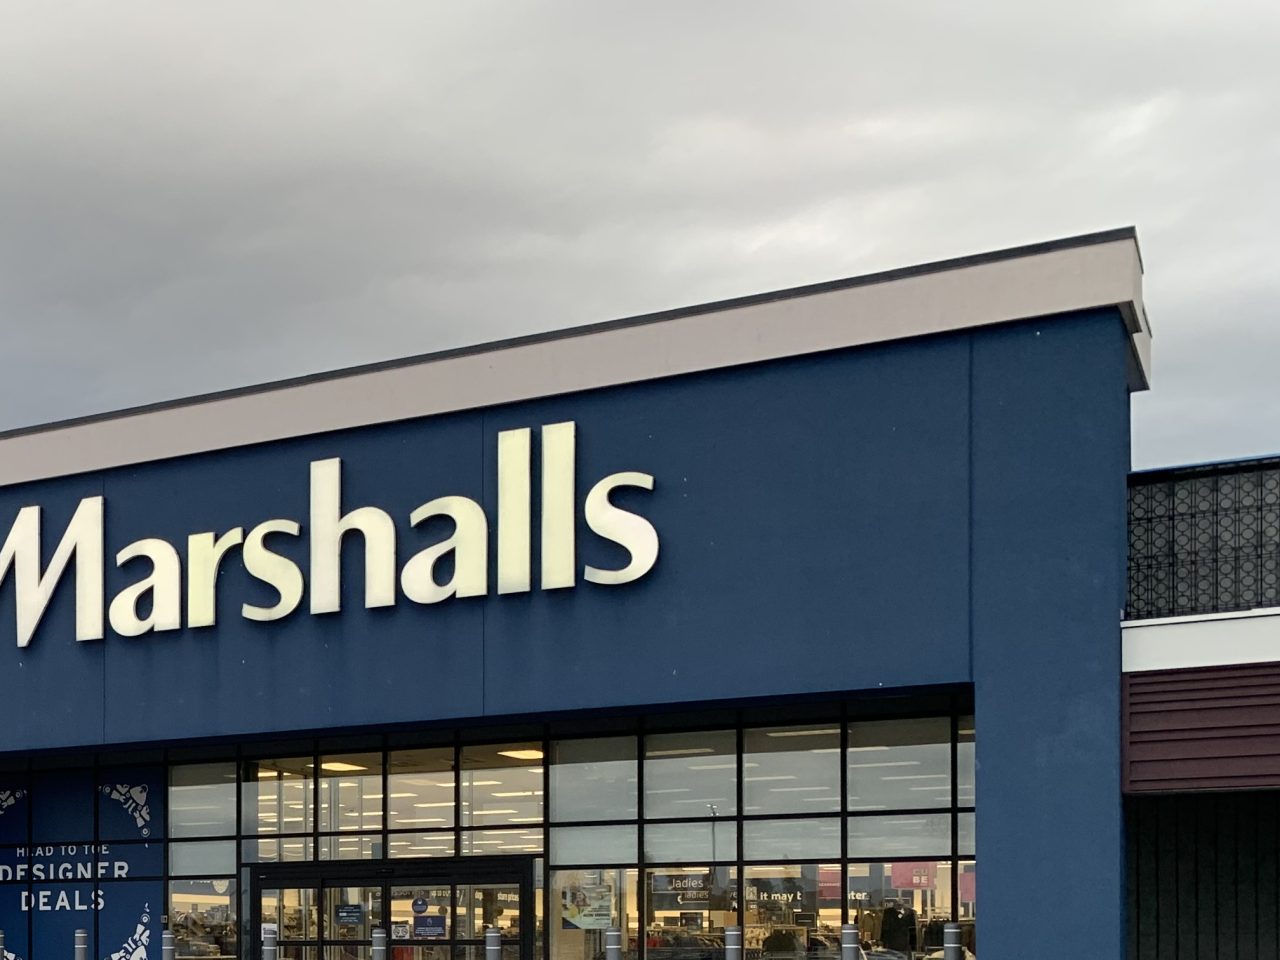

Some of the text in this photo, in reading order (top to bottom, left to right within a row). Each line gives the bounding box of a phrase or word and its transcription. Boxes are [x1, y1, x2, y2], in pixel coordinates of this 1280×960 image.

[60, 845, 77, 856] TO
[672, 878, 704, 888] ladies
[21, 889, 105, 911] DEALS
[771, 892, 794, 902] may
